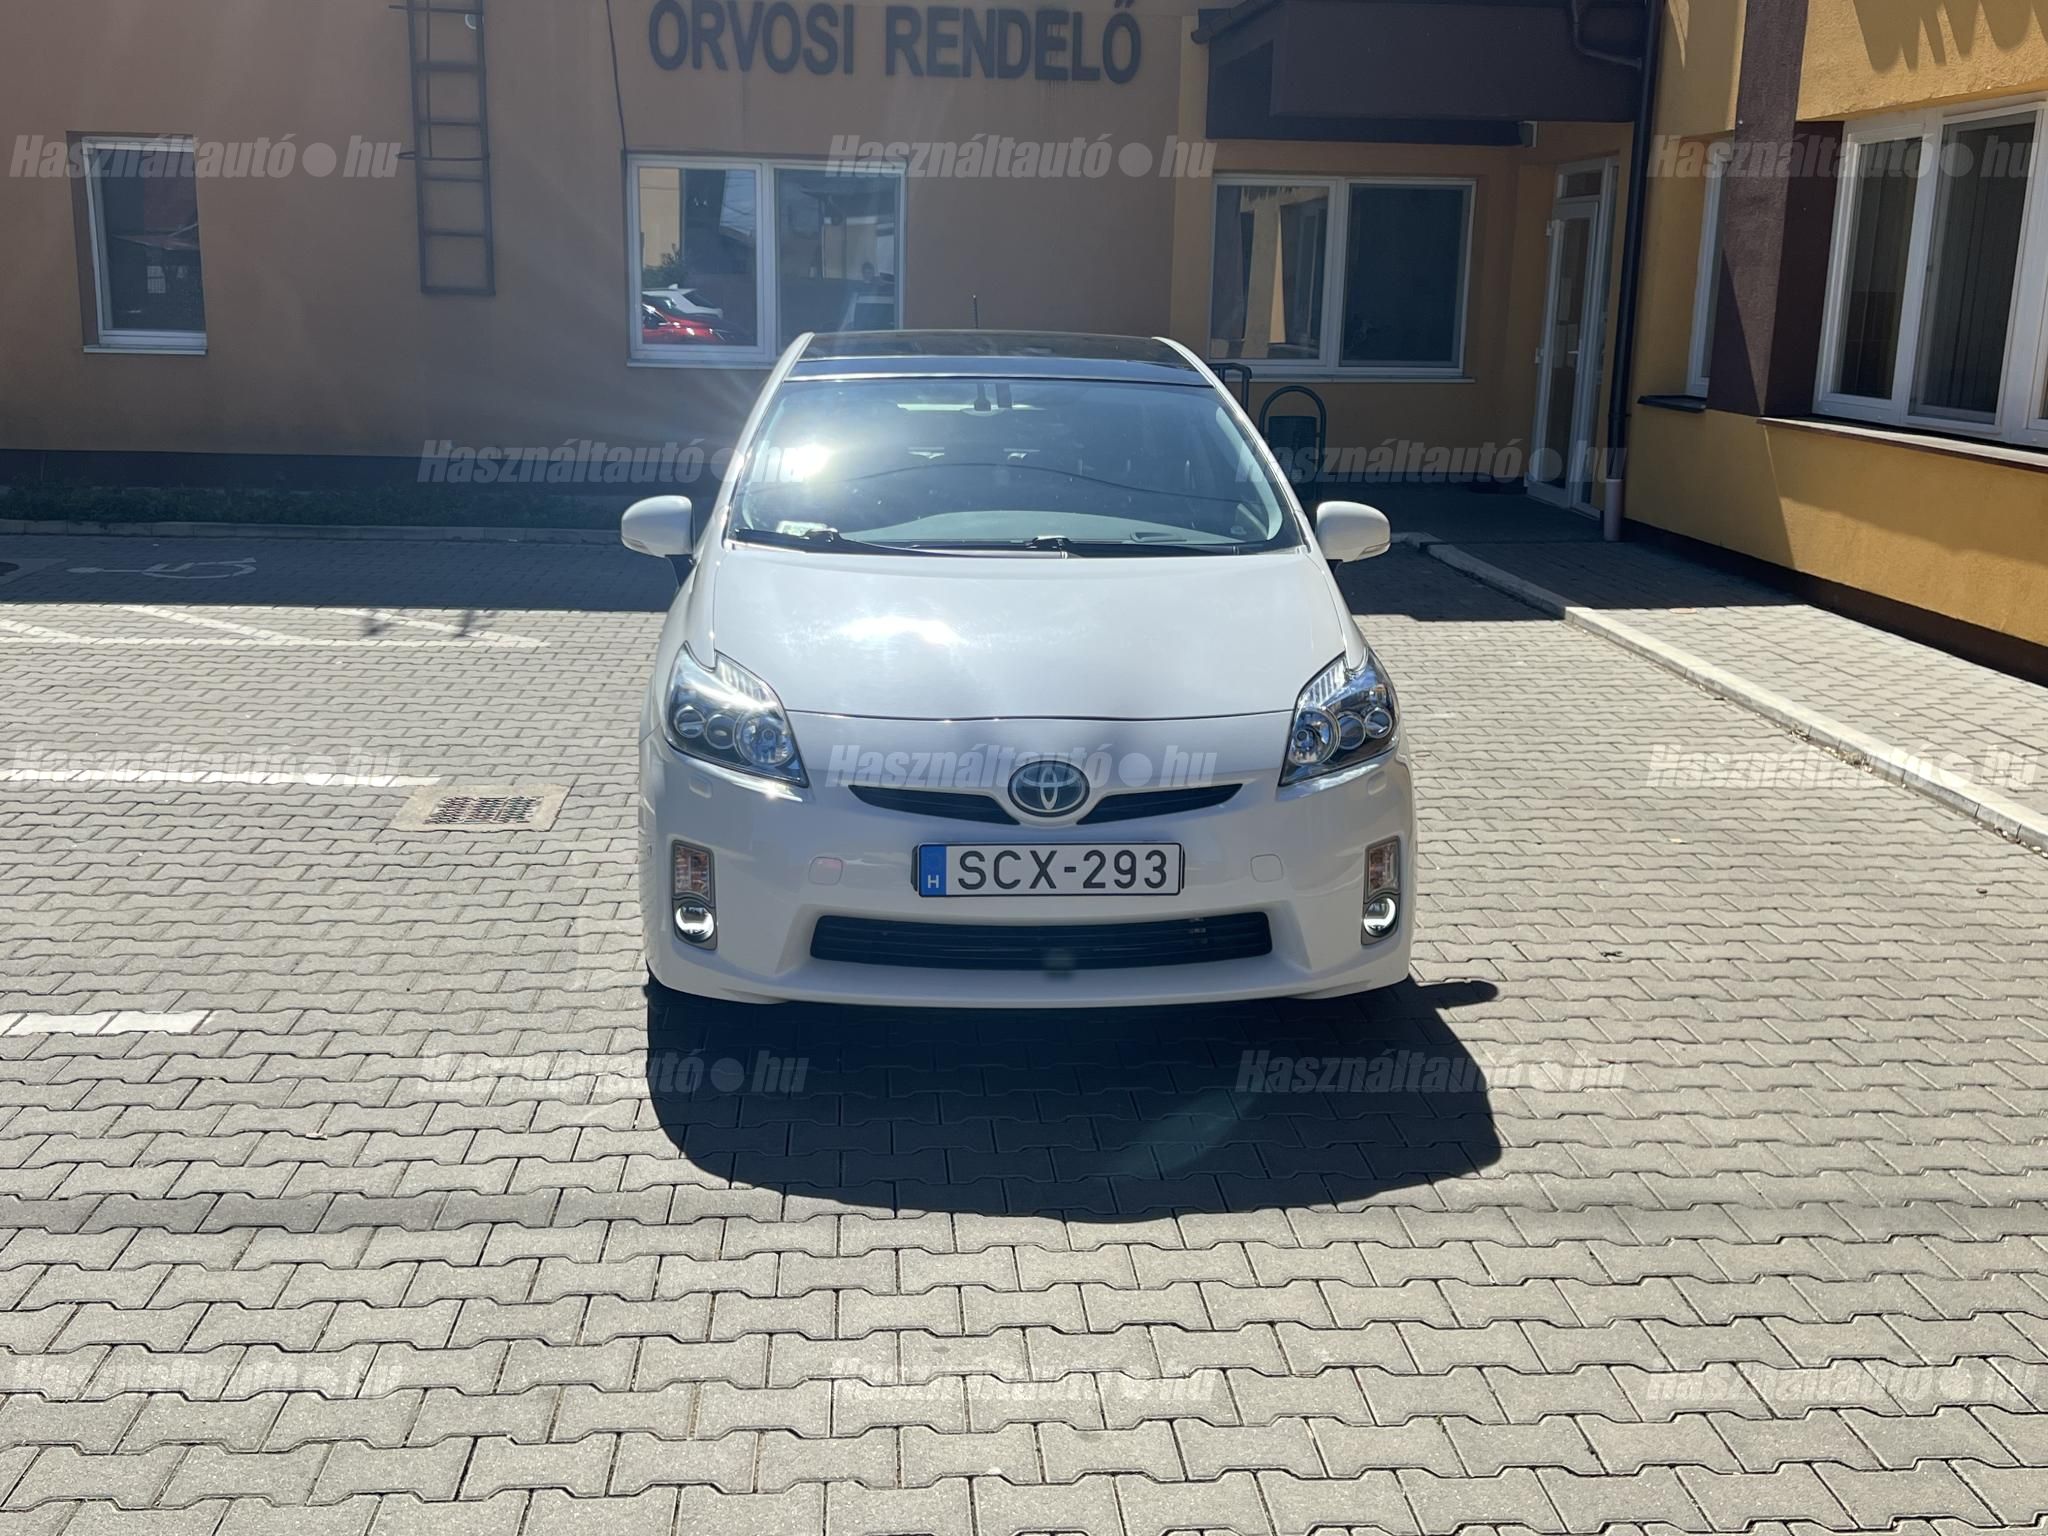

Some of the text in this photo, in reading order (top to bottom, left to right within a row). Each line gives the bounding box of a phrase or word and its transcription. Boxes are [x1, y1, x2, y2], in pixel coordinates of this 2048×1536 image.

[648, 0, 1142, 85] ORVOSI RENDELŐ
[927, 850, 1167, 890] H SCX-293
